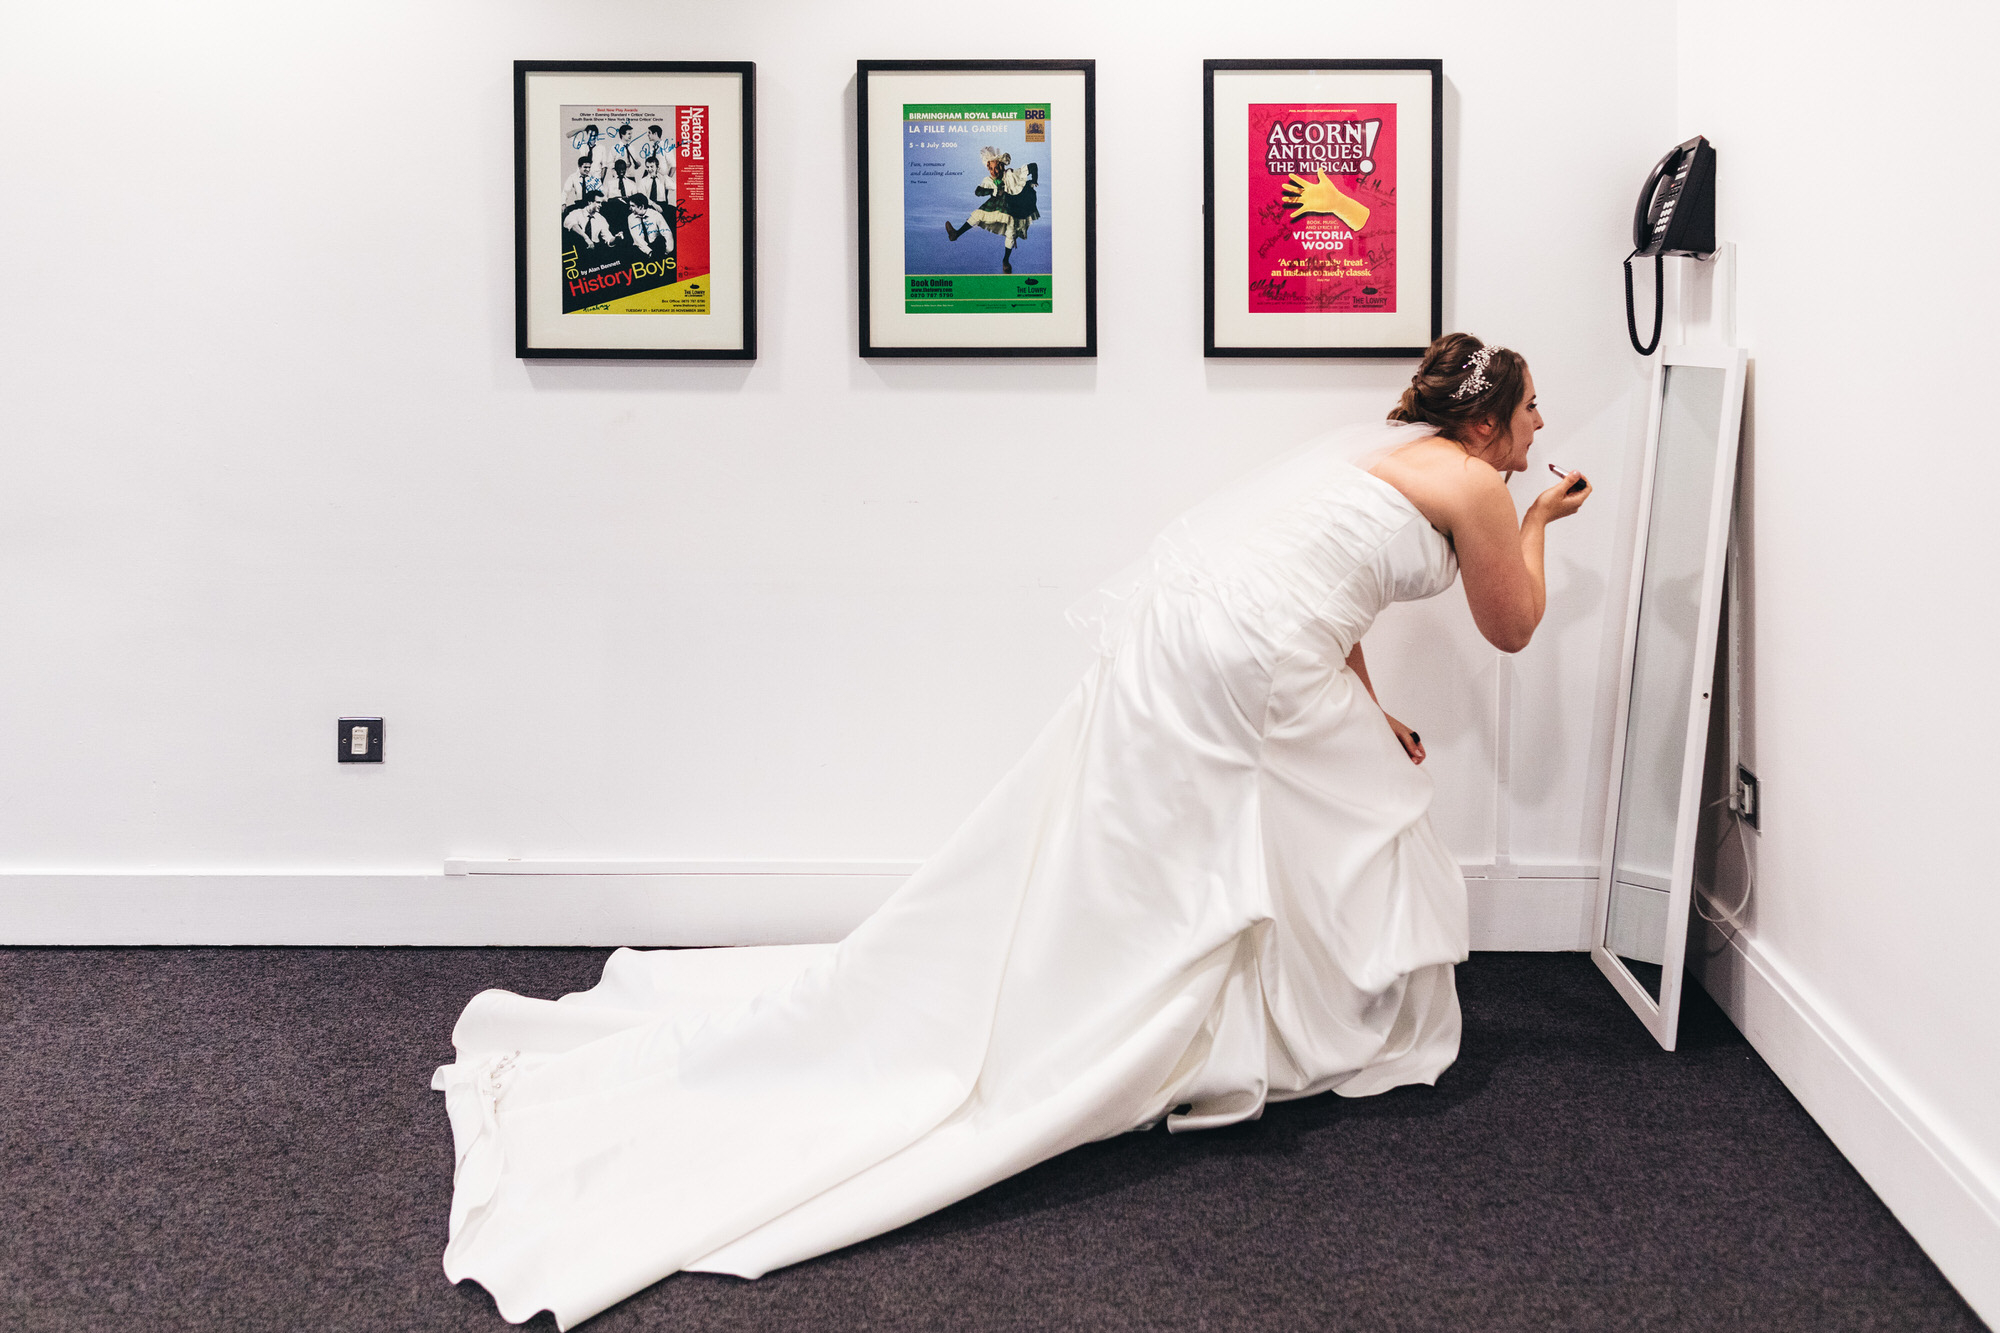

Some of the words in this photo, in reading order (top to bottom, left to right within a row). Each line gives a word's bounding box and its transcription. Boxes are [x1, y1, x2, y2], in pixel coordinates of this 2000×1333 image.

[1025, 110, 1045, 120] BRB
[681, 107, 691, 157] Theatre
[692, 108, 704, 160] National
[1268, 145, 1362, 161] ANTIQUES
[1268, 162, 1295, 172] THE
[1300, 162, 1357, 172] MUSICAL
[1293, 231, 1353, 240] VICTORIA
[1302, 241, 1344, 250] WOOD
[562, 245, 579, 279] The
[588, 265, 600, 273] Alan
[600, 260, 621, 270] Bennett
[569, 268, 632, 297] History
[631, 257, 676, 279] Boys
[1283, 269, 1312, 277] instant
[1313, 269, 1344, 278] comedy
[1346, 268, 1372, 276] classic
[1028, 286, 1046, 294] LOWRY
[1366, 296, 1387, 305] LOWRY
